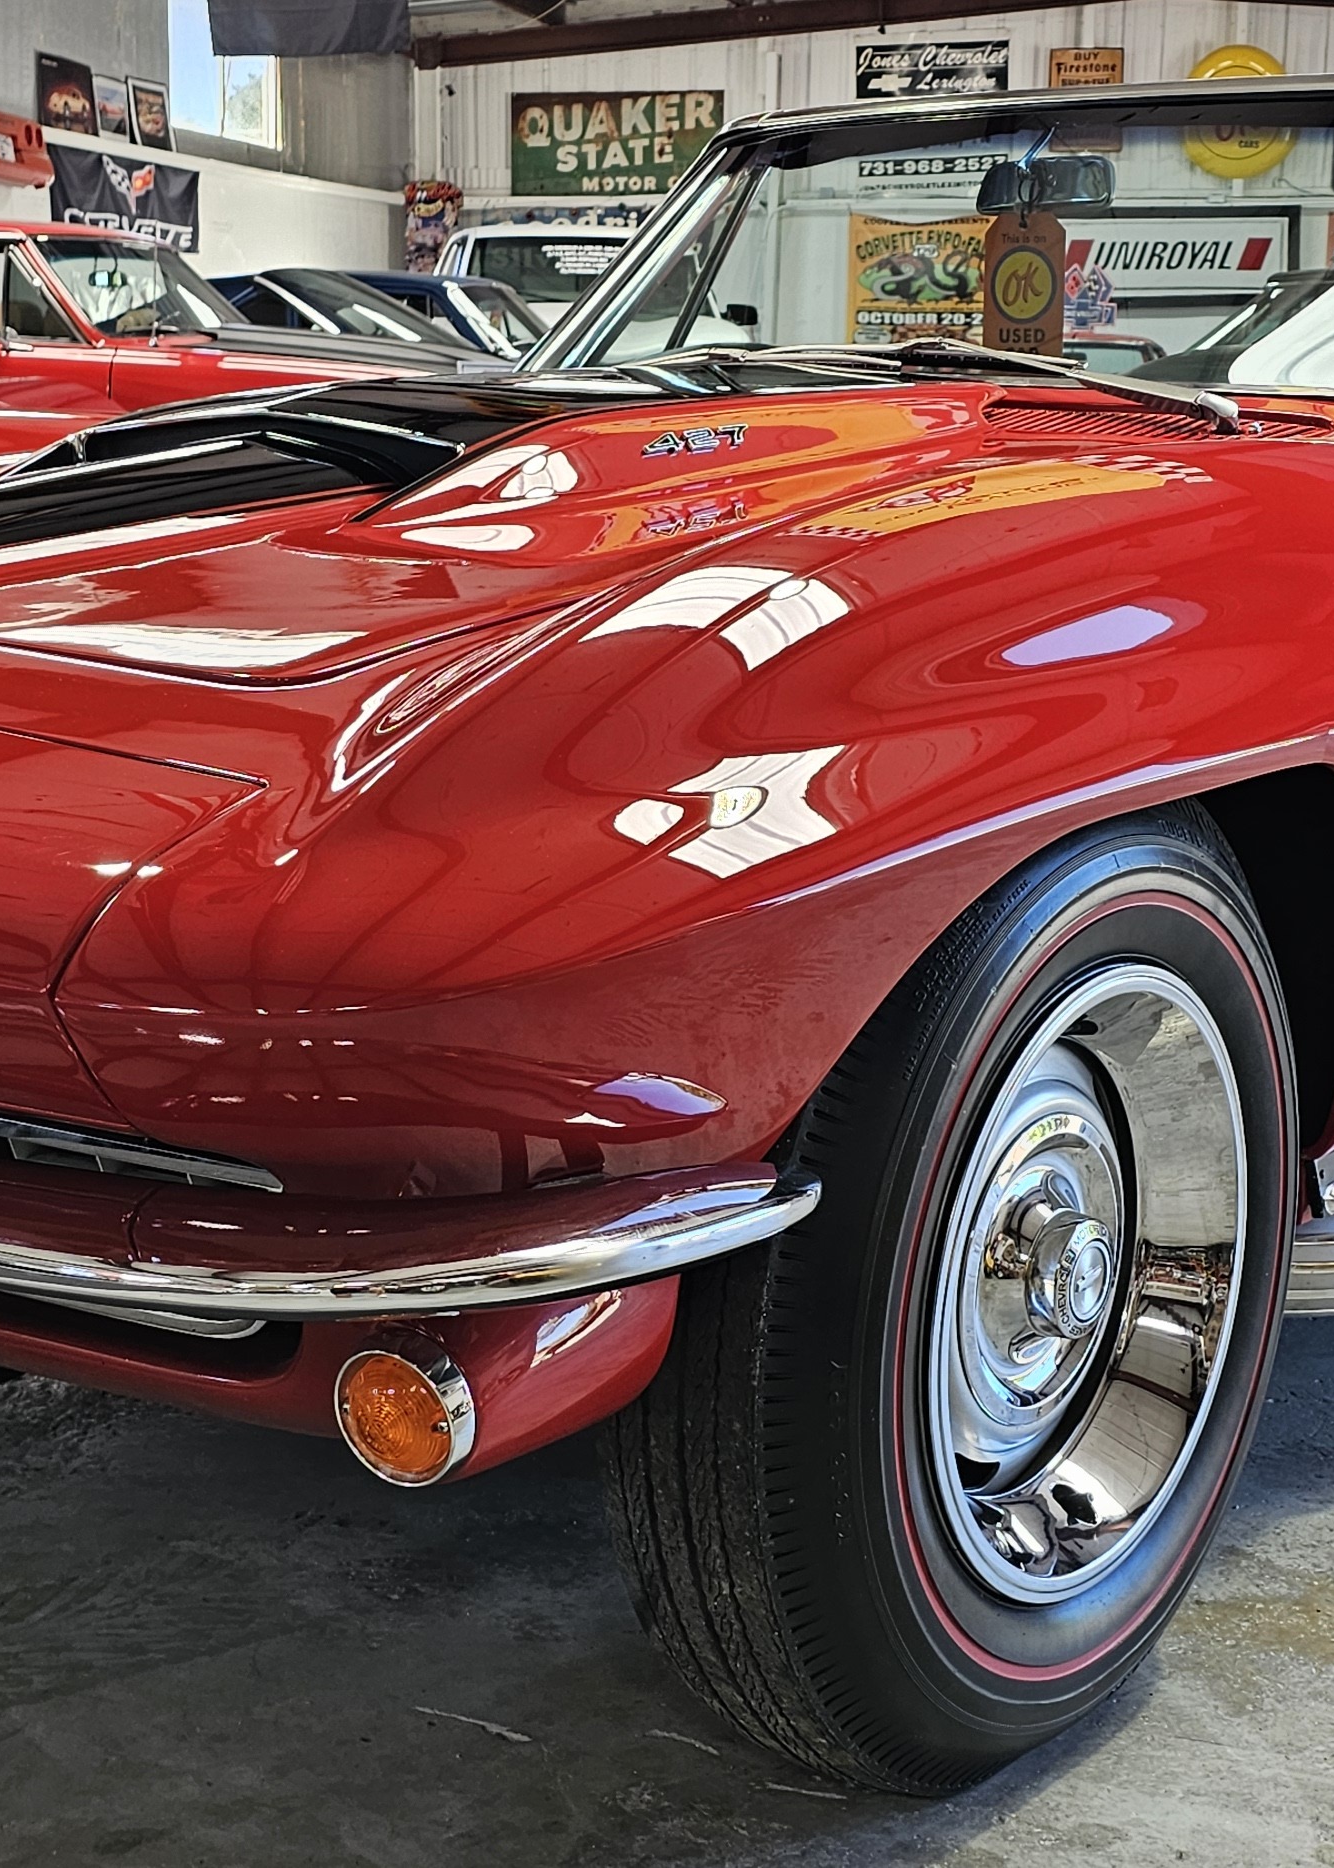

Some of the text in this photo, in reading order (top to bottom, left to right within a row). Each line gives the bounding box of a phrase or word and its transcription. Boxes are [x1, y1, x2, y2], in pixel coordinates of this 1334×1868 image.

[857, 44, 1010, 76] Jones Chevrolet
[1055, 62, 1117, 74] Firestone
[1074, 52, 1100, 61] BUY
[916, 72, 997, 91] Lexington
[518, 92, 716, 147] QUAKER
[556, 137, 674, 173] STATE
[582, 175, 657, 192] MOTOR
[856, 230, 924, 262] CORVETTE
[1001, 234, 1047, 244] This is an
[1094, 240, 1234, 270] UNIROYAL
[1001, 261, 1044, 308] OK
[857, 311, 984, 325] OCTOBER 20-2
[999, 328, 1046, 344] USED
[641, 423, 749, 457] 427
